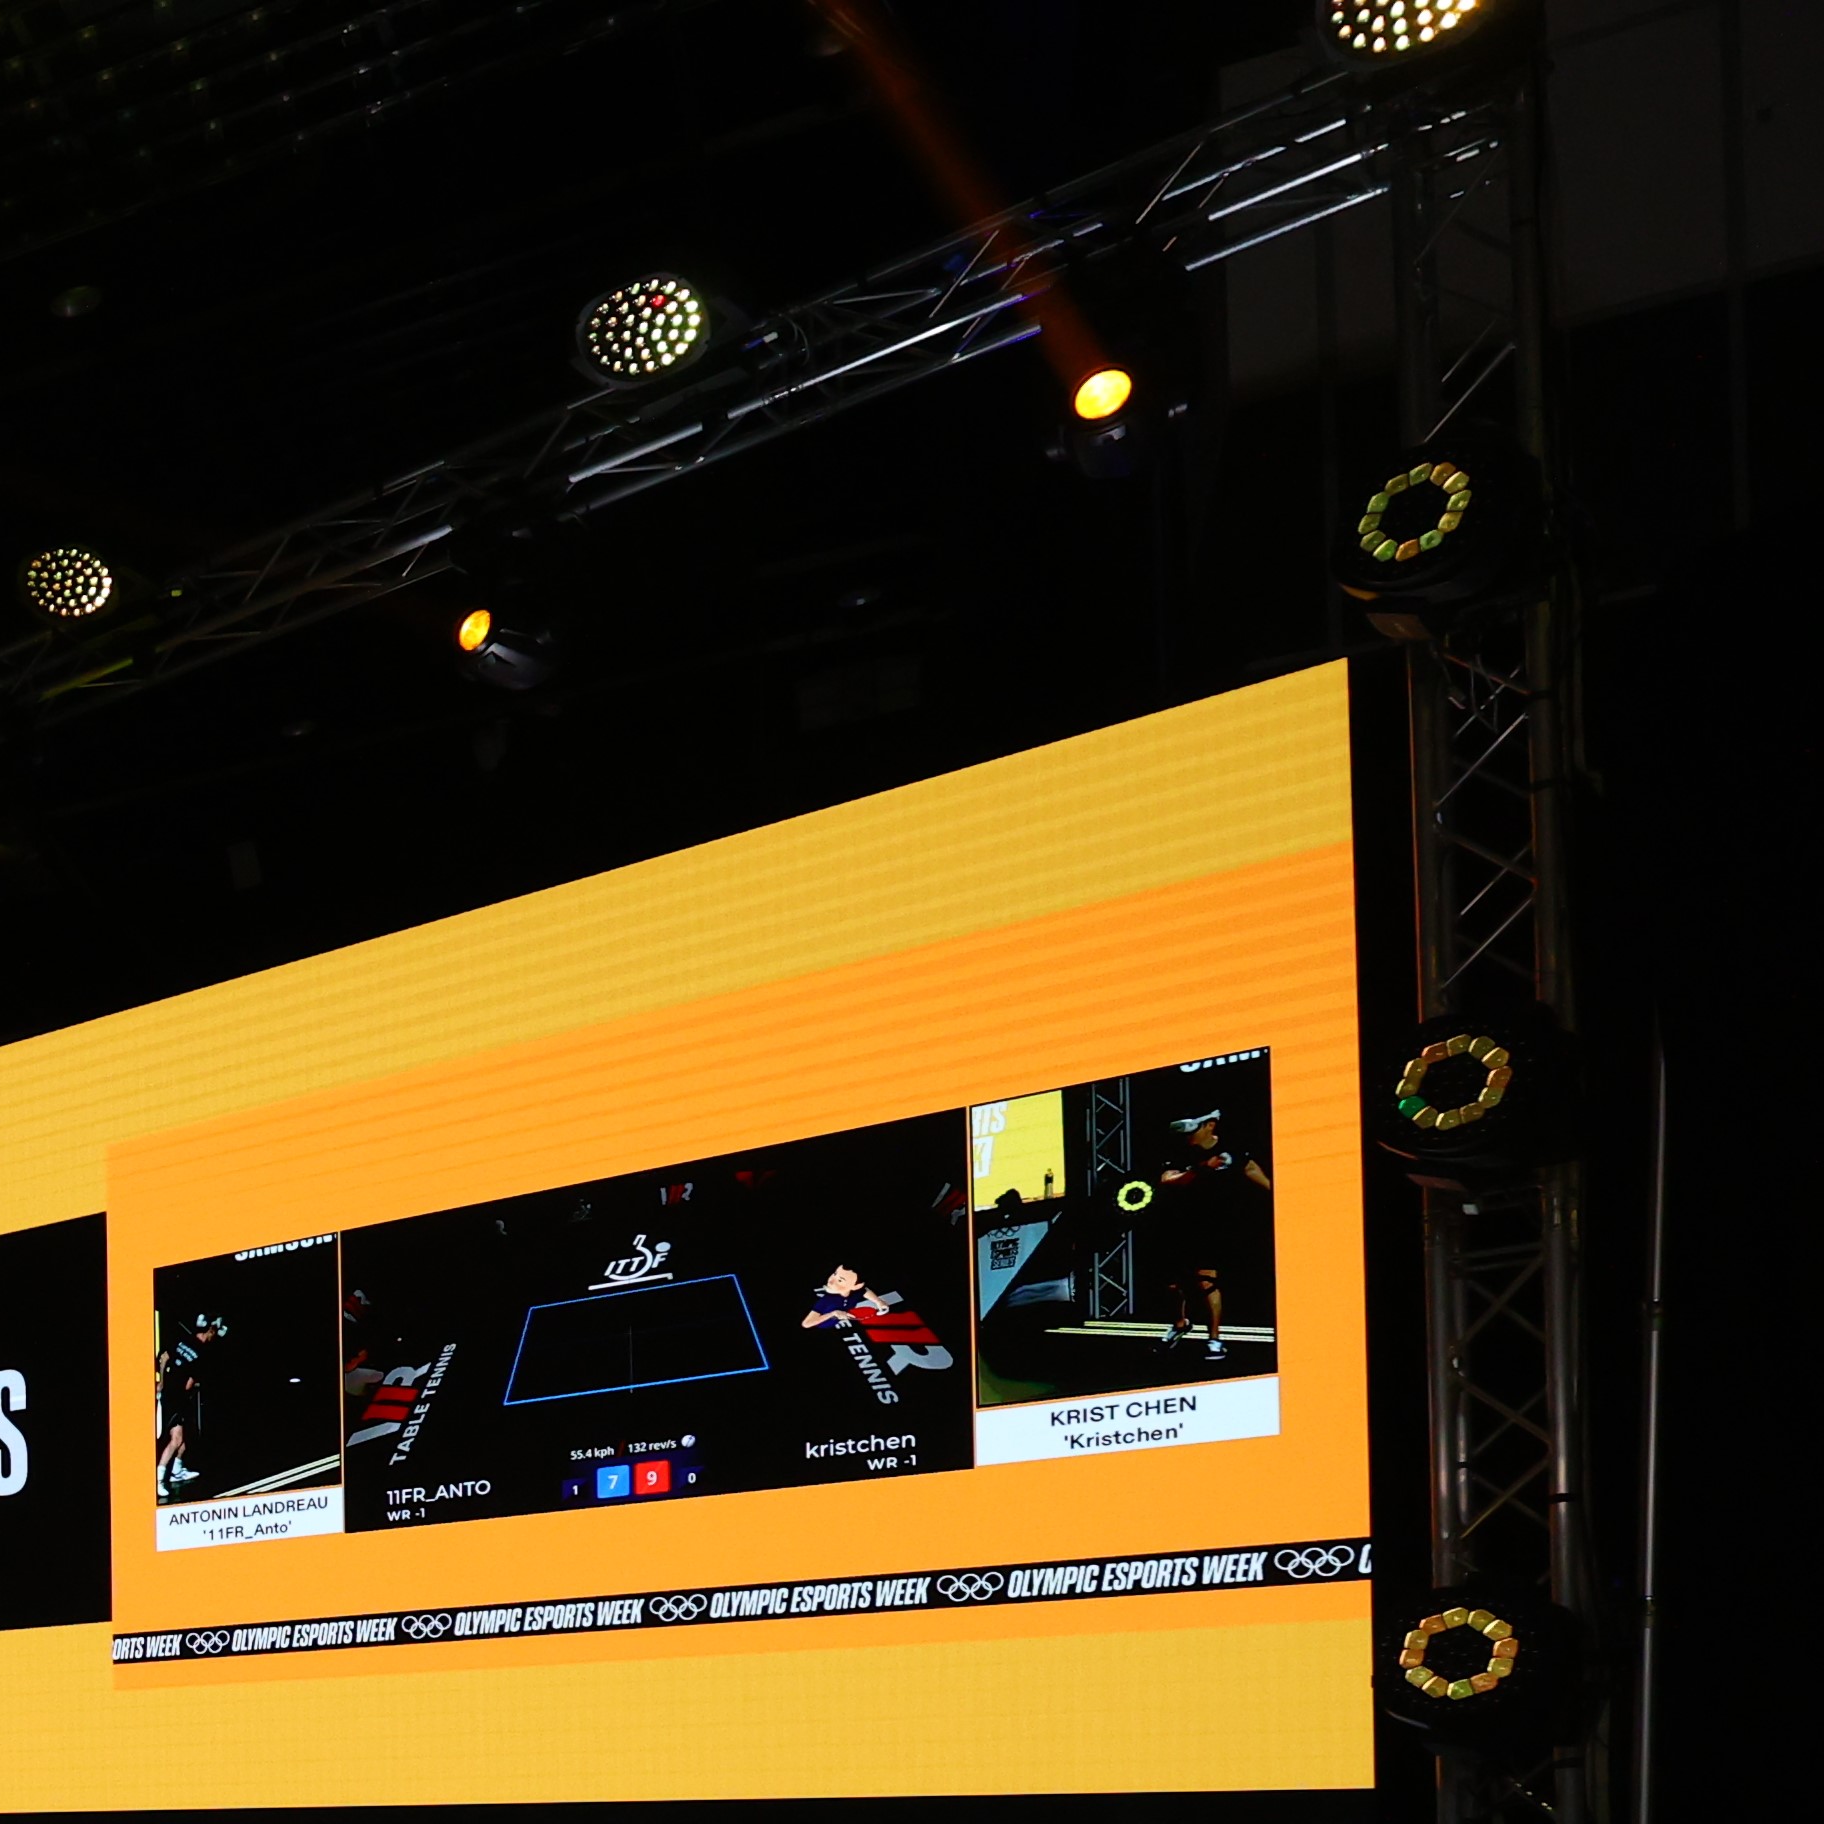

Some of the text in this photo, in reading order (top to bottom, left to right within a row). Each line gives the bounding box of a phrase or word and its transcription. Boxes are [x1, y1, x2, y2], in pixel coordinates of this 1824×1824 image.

[843, 1333, 899, 1404] TENNIS
[389, 1343, 457, 1466] TABLE TENNIS
[1051, 1395, 1198, 1427] KRIST CHEN
[570, 1439, 677, 1460] 55.4 kph 132 rev/s
[805, 1434, 917, 1459] kristchen
[1063, 1423, 1184, 1449] 'Kristchen'
[867, 1454, 917, 1470] WR -1
[386, 1479, 492, 1506] 11FR_ANTO
[572, 1470, 697, 1496] 1 7 9 0
[169, 1496, 329, 1526] ANTONIN LANDREAU
[387, 1508, 426, 1522] WR -1
[202, 1520, 293, 1541] '11FR_Anto'
[1007, 1552, 1269, 1598] OLYMPIC ESPORTS WEEK
[709, 1577, 932, 1618] OLYMPIC ESPORTS WEEK
[454, 1599, 645, 1636] OLYMPIC ESPORTS WEEK
[146, 1634, 183, 1658] WEEK
[231, 1617, 398, 1652] OLYMPIC ESPORTS WEEK
